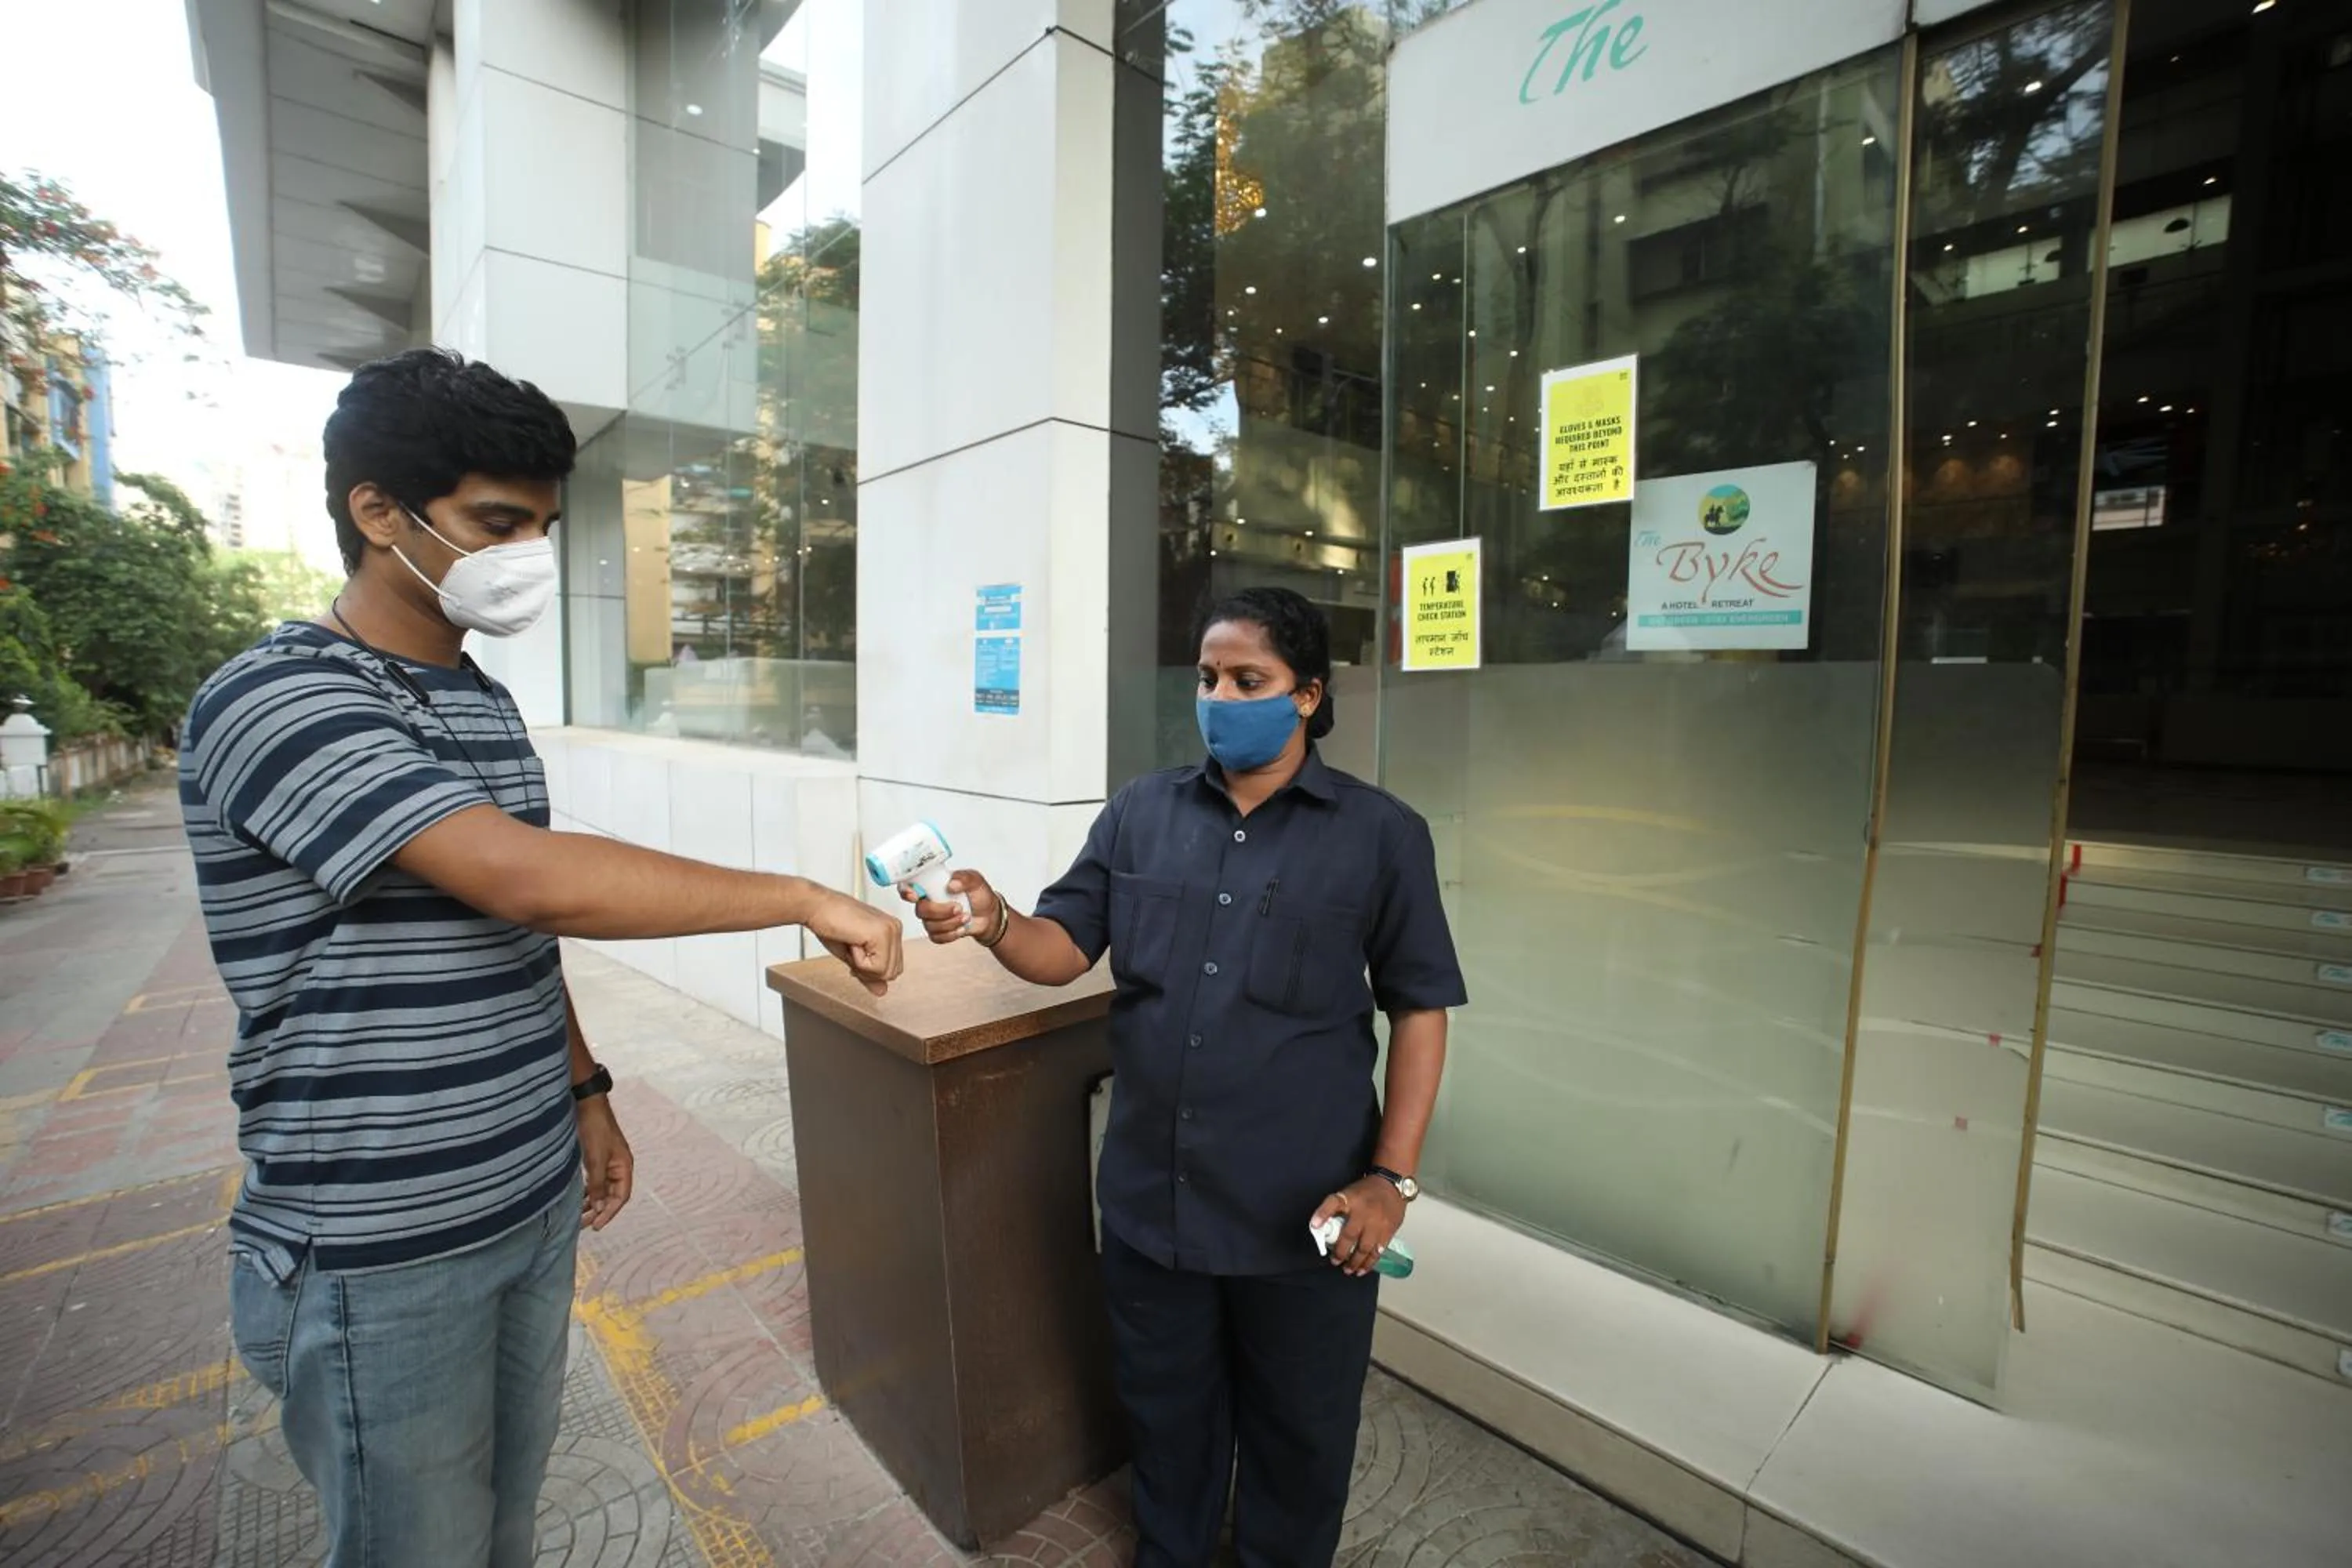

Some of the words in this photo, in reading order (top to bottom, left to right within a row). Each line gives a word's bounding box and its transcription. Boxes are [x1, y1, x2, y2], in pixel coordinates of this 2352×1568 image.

[1519, 0, 1649, 104] The
[1595, 416, 1621, 427] MASKS
[1592, 426, 1622, 438] BEYOND
[1570, 443, 1585, 452] THIS
[1588, 439, 1609, 450] POINT
[1656, 537, 1804, 604] Byke
[1420, 600, 1464, 611] TEMPERATURE
[1669, 601, 1698, 609] HOTEL
[1711, 598, 1755, 608] RETREAT
[1417, 612, 1439, 622] CHECK
[1440, 610, 1466, 619] STATION
